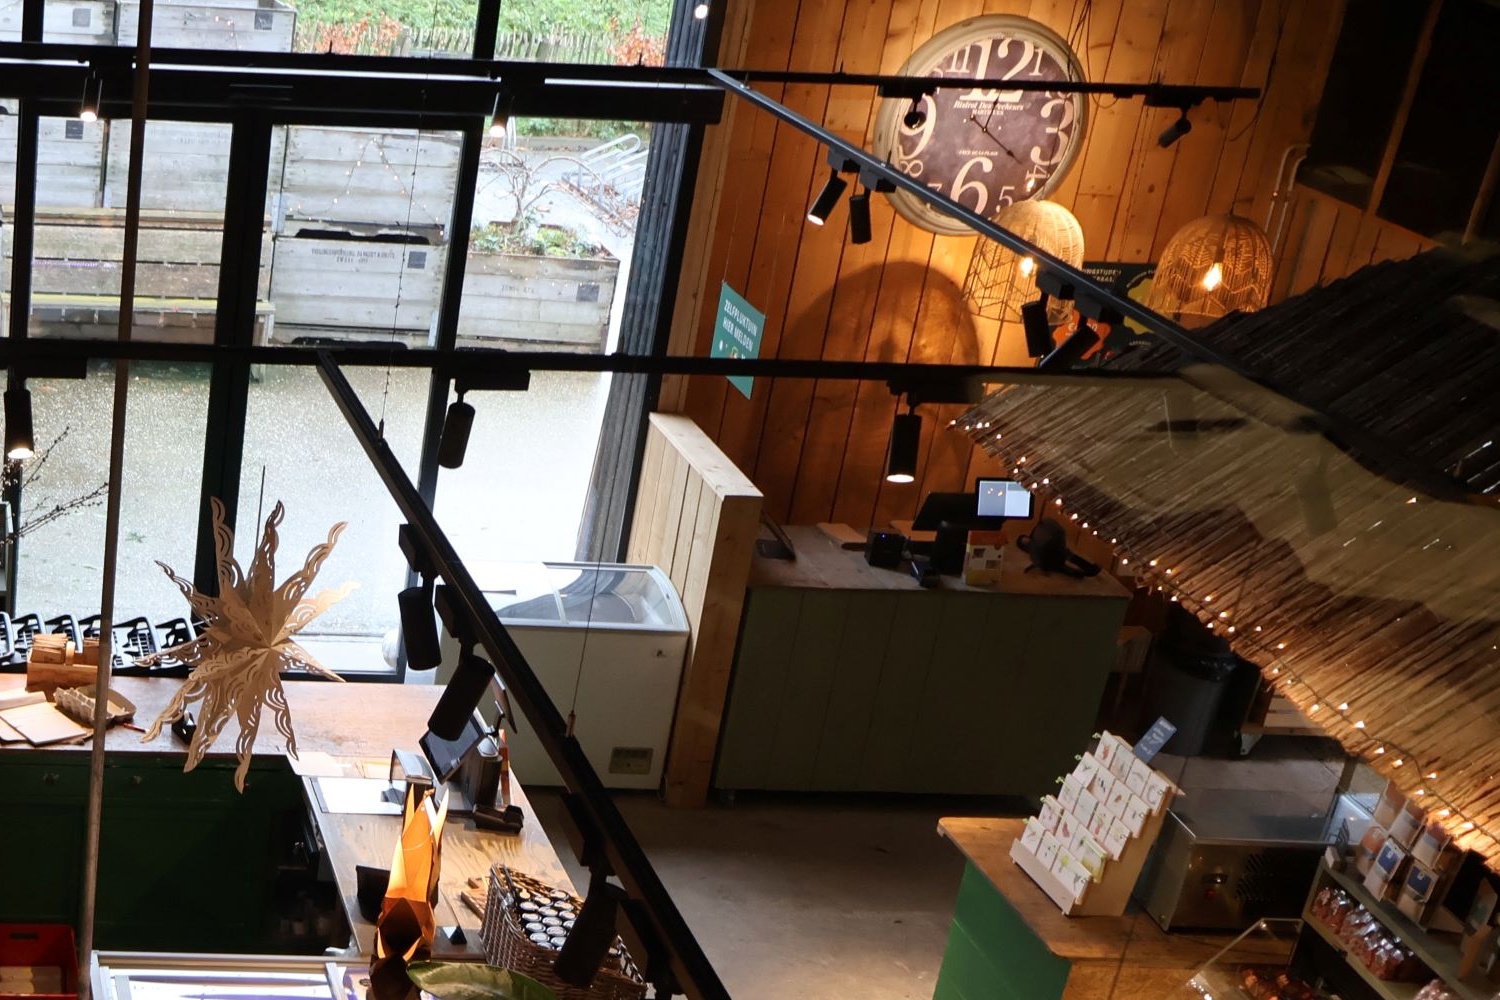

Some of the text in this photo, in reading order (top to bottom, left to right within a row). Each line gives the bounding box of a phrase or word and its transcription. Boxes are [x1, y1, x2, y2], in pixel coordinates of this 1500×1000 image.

[946, 45, 971, 74] 11
[959, 38, 1035, 102] 12
[899, 92, 937, 160] 9
[1030, 99, 1074, 166] 3
[951, 156, 993, 215] 6
[722, 316, 754, 352] HIER MELDEN
[723, 298, 758, 337] ZELFPLUKTUIN
